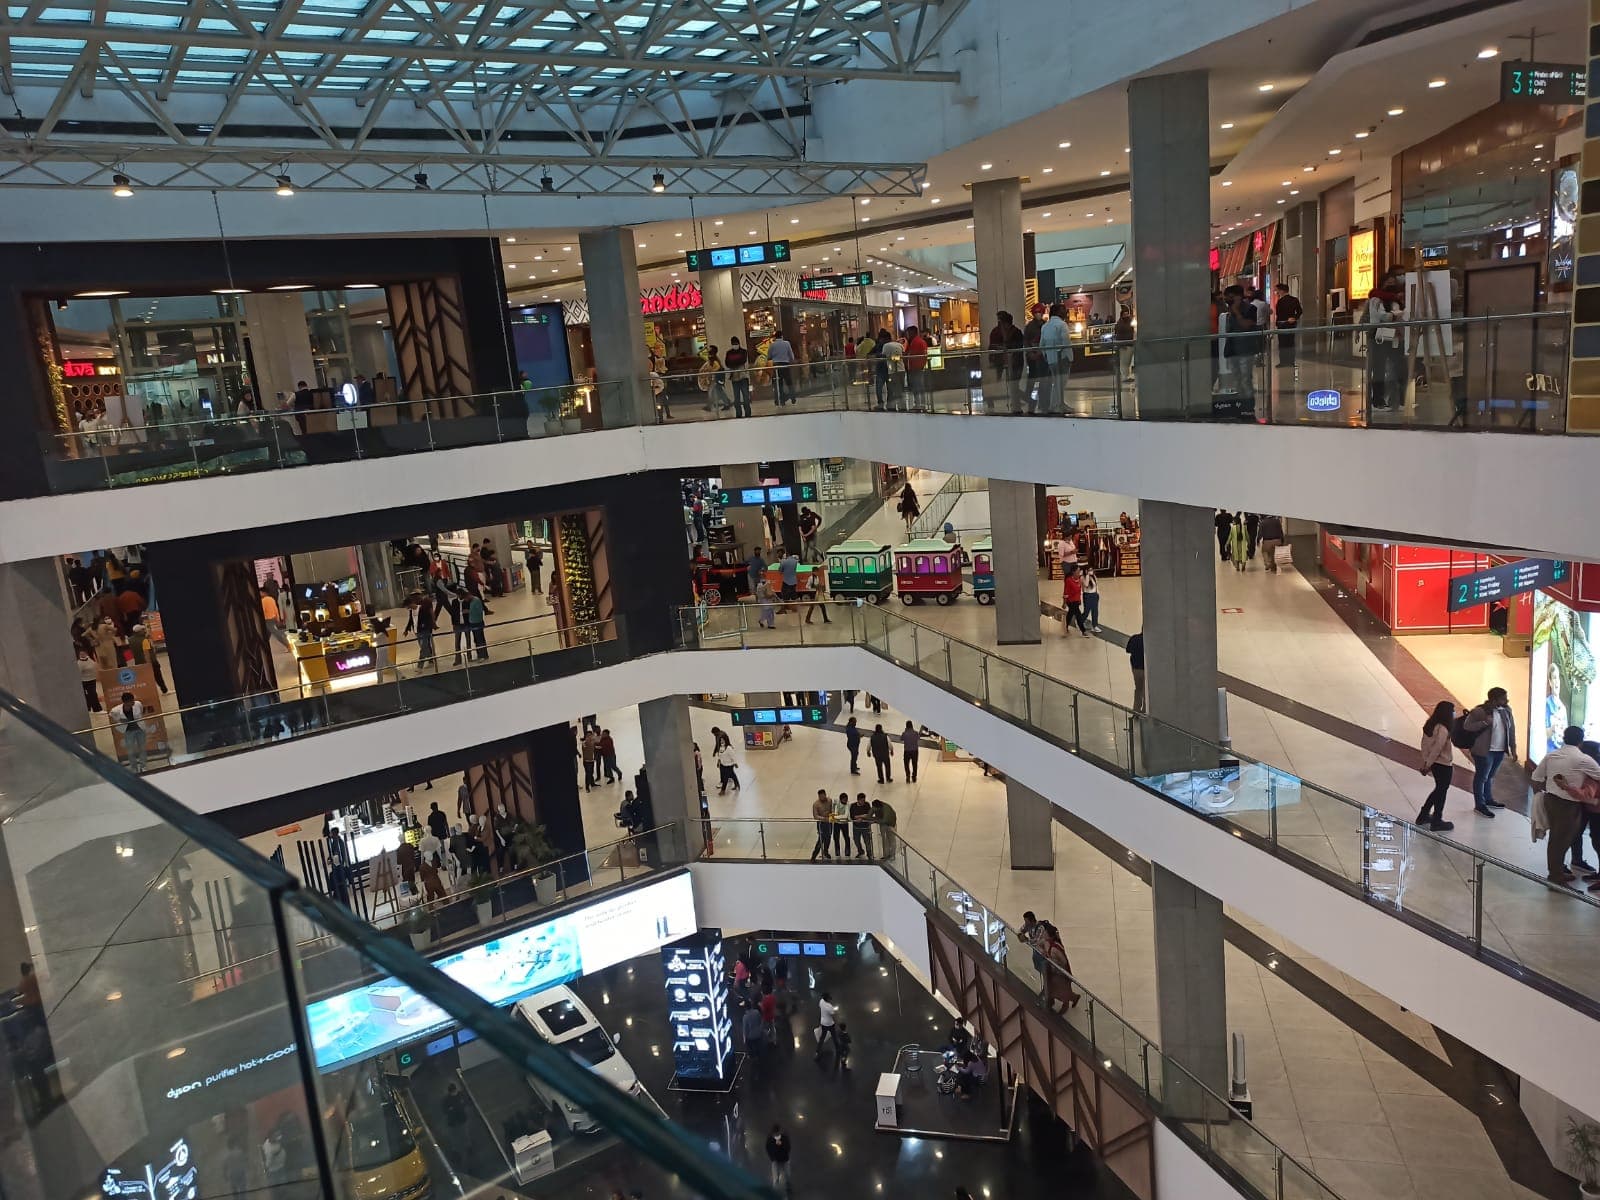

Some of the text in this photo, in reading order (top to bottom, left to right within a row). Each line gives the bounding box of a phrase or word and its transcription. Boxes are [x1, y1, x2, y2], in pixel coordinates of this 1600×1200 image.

[1512, 71, 1522, 93] 3
[690, 255, 698, 266] 3
[721, 493, 729, 503] 2
[1458, 584, 1468, 603] 2
[734, 712, 740, 722] 1
[758, 944, 768, 953] G
[400, 1053, 411, 1064] G
[166, 1081, 203, 1099] dyson
[205, 1066, 239, 1087] purifier
